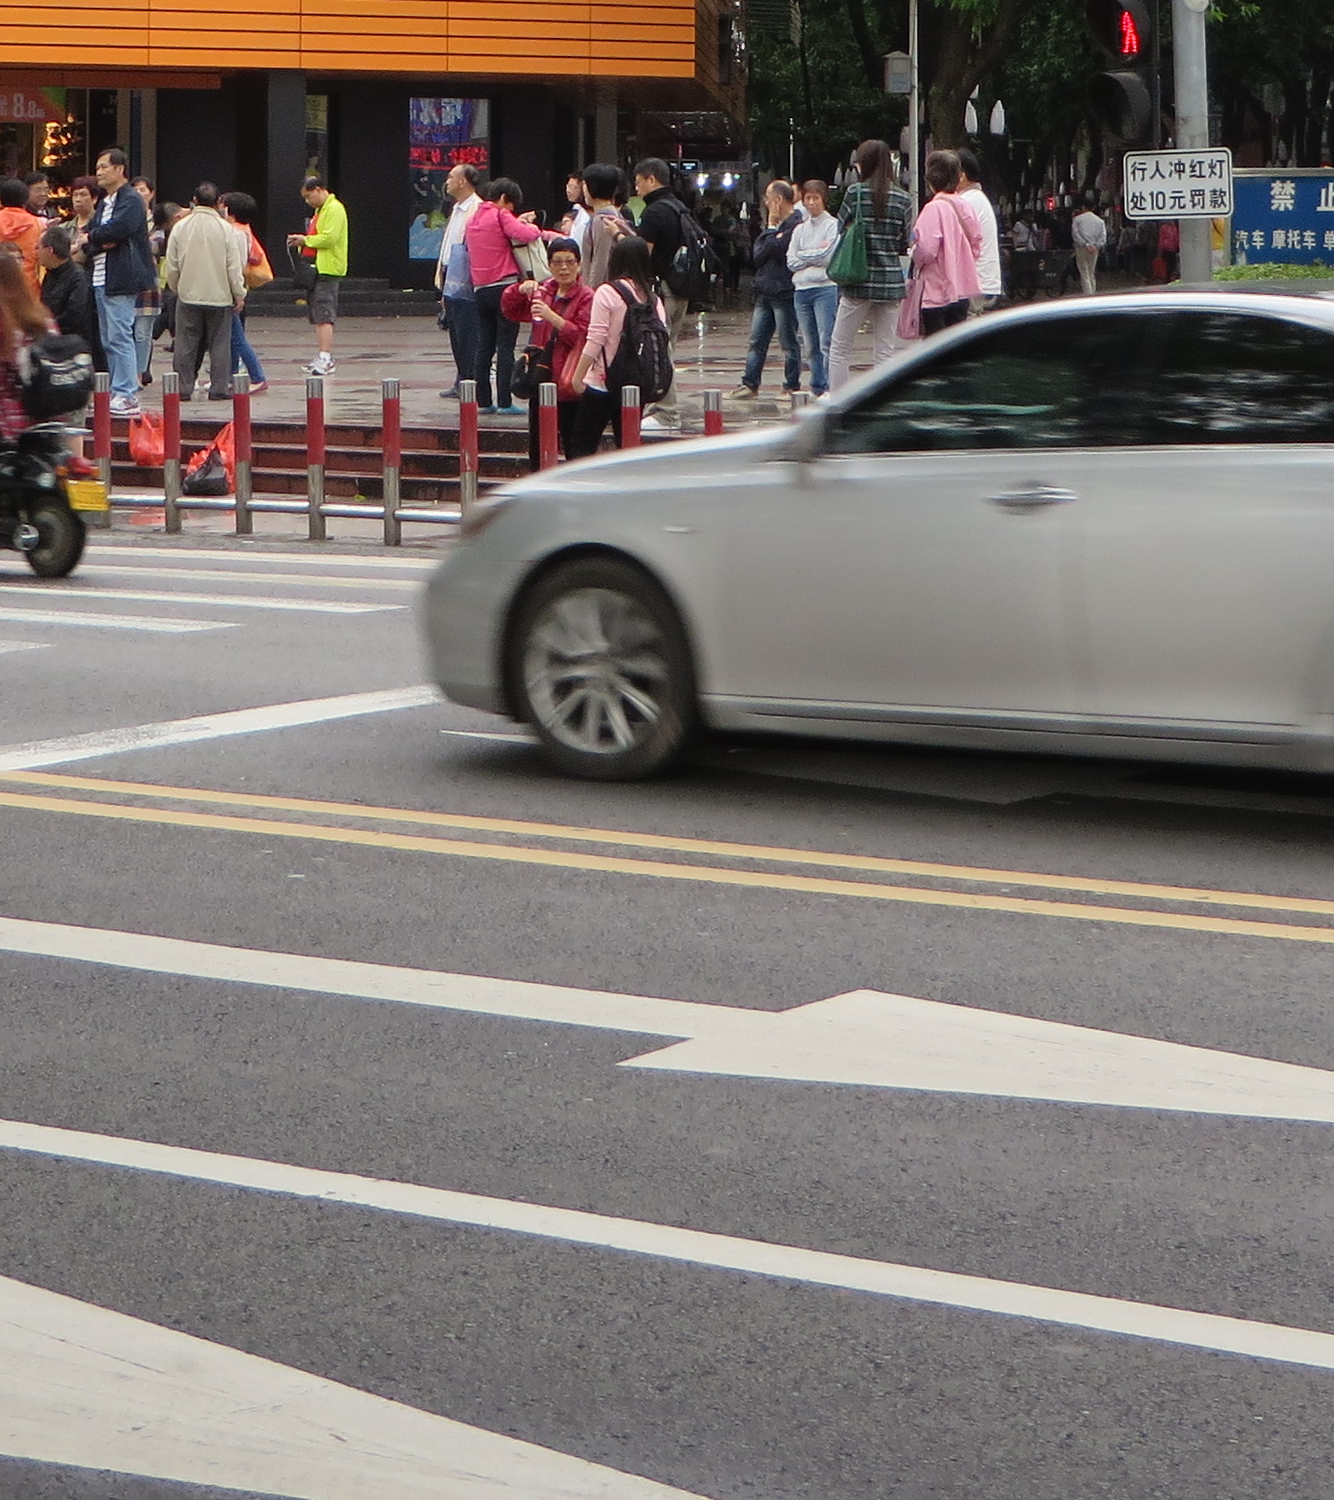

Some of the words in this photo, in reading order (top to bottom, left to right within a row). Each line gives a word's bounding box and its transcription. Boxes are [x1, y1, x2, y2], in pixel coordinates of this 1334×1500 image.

[1130, 158, 1225, 181] 行人冲红灯
[1130, 188, 1229, 211] 处10元罚款
[1234, 230, 1265, 250] 汽车
[1271, 230, 1316, 250] 摩托车
